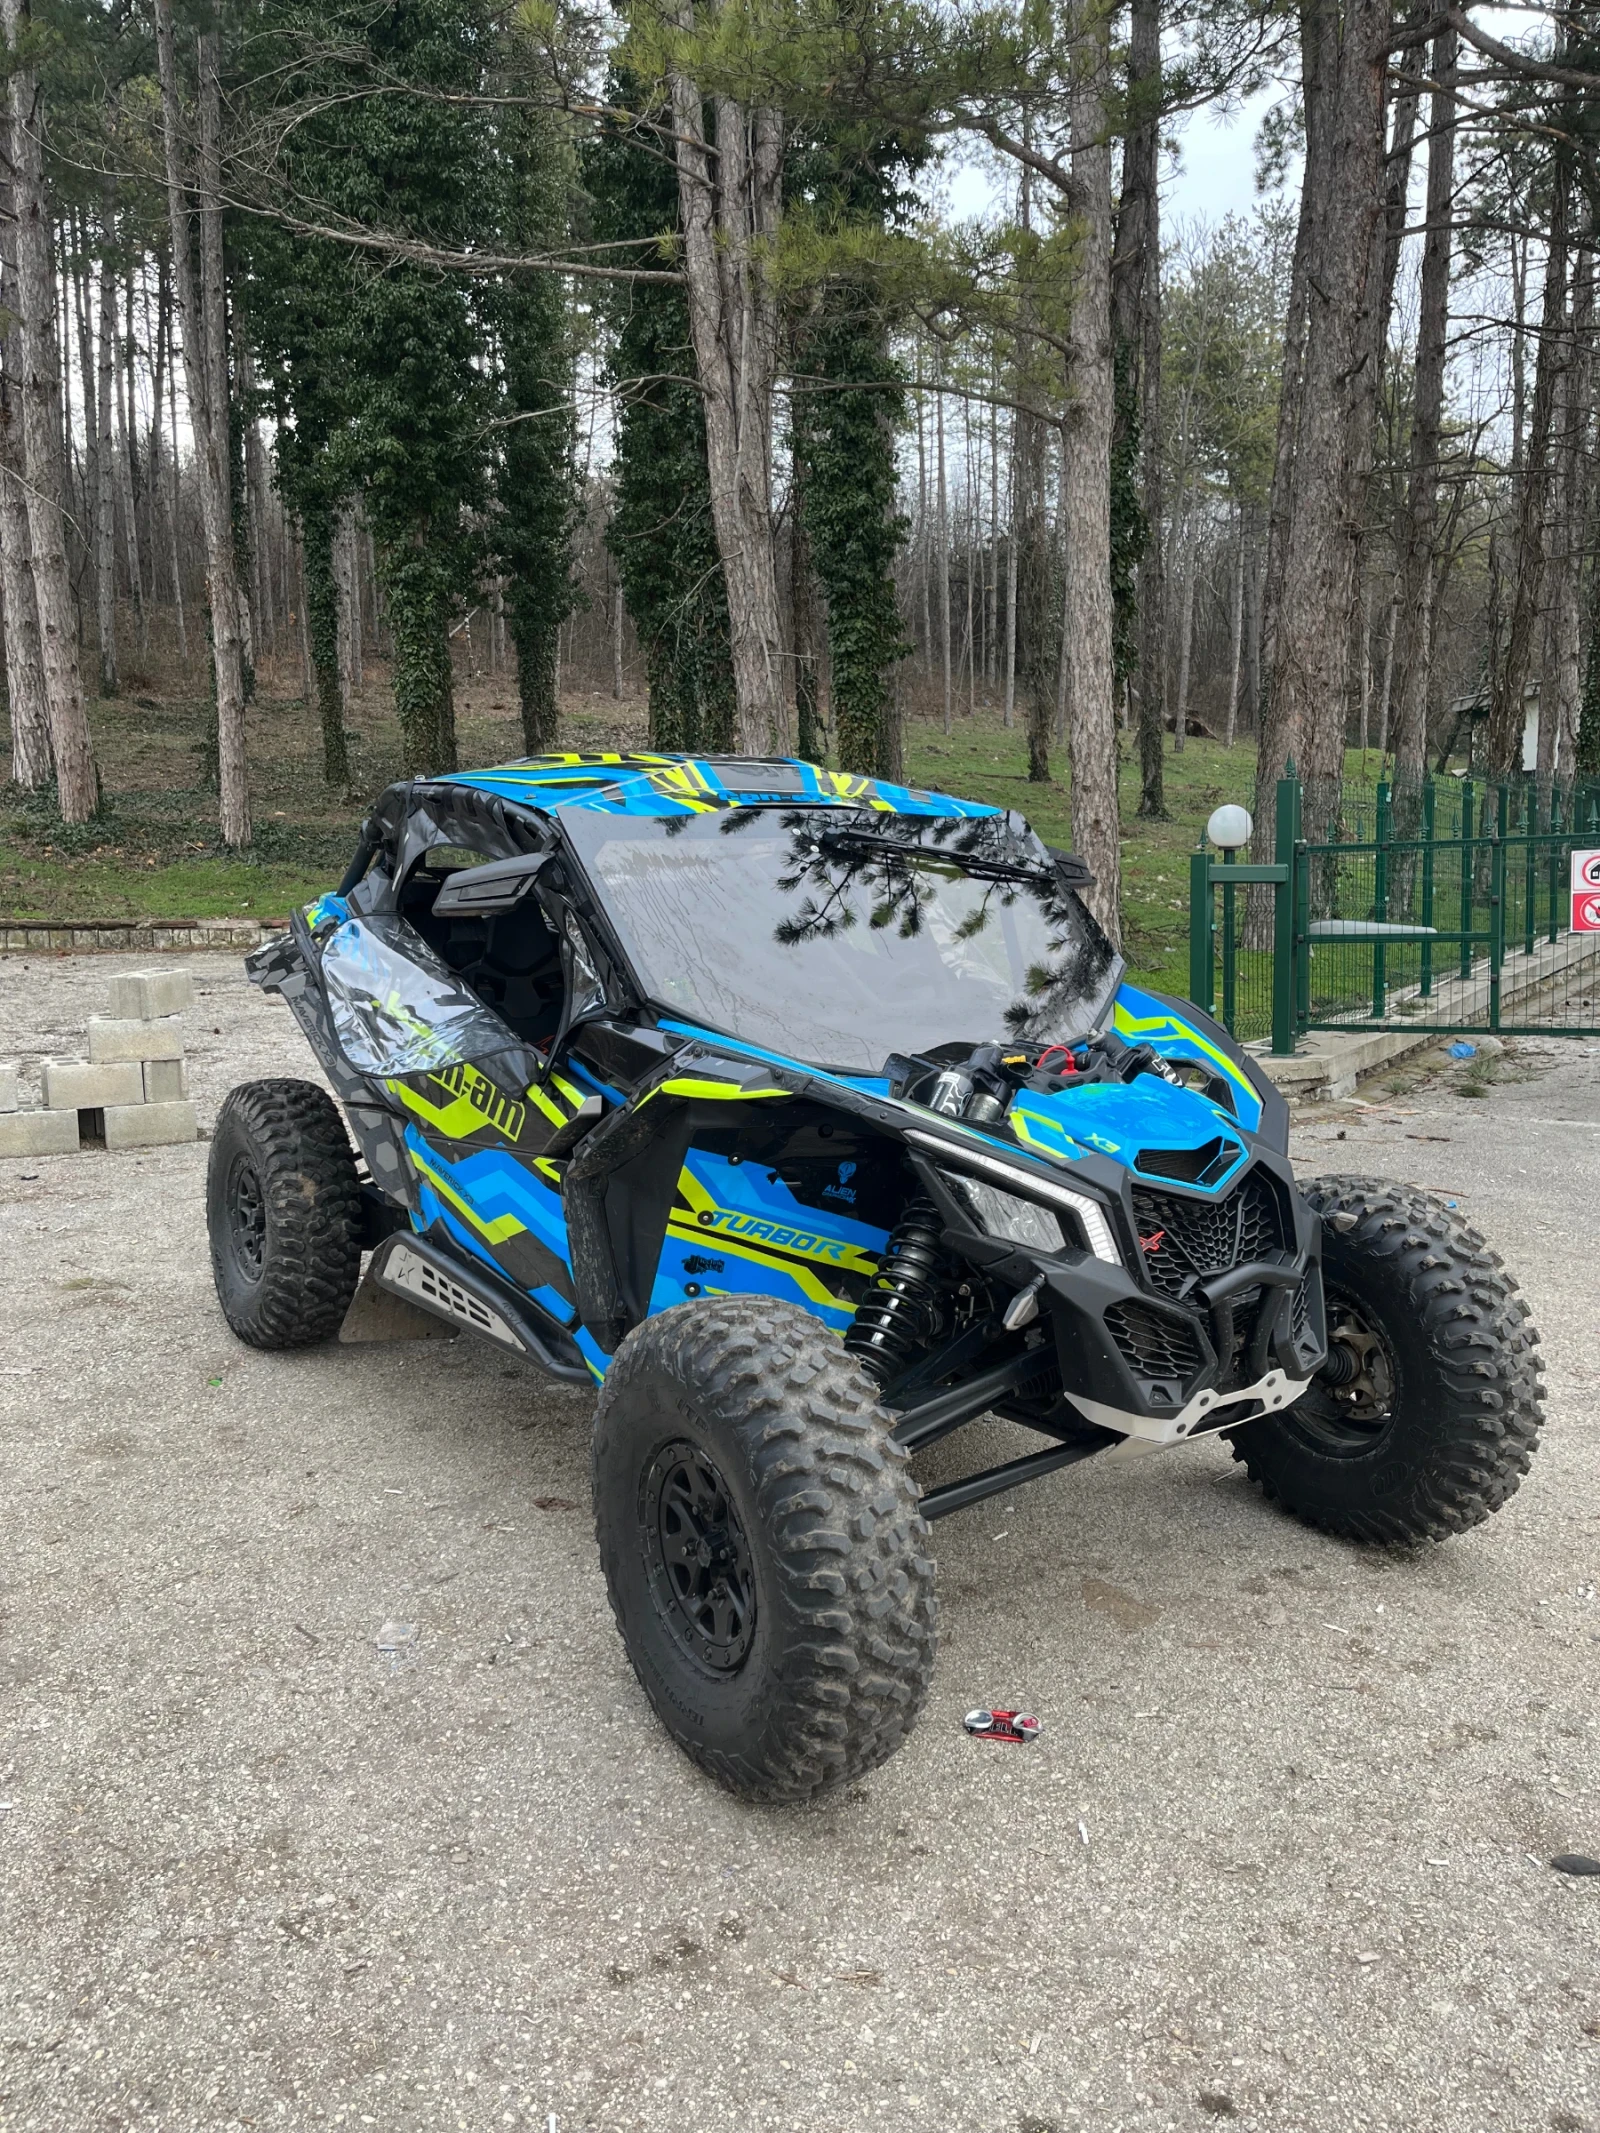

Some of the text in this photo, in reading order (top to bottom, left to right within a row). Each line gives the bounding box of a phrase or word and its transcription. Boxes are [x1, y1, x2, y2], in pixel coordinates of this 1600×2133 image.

[291, 996, 337, 1066] MAVERICK X3
[1083, 1132, 1121, 1153] X3
[823, 1184, 857, 1197] ALIEN
